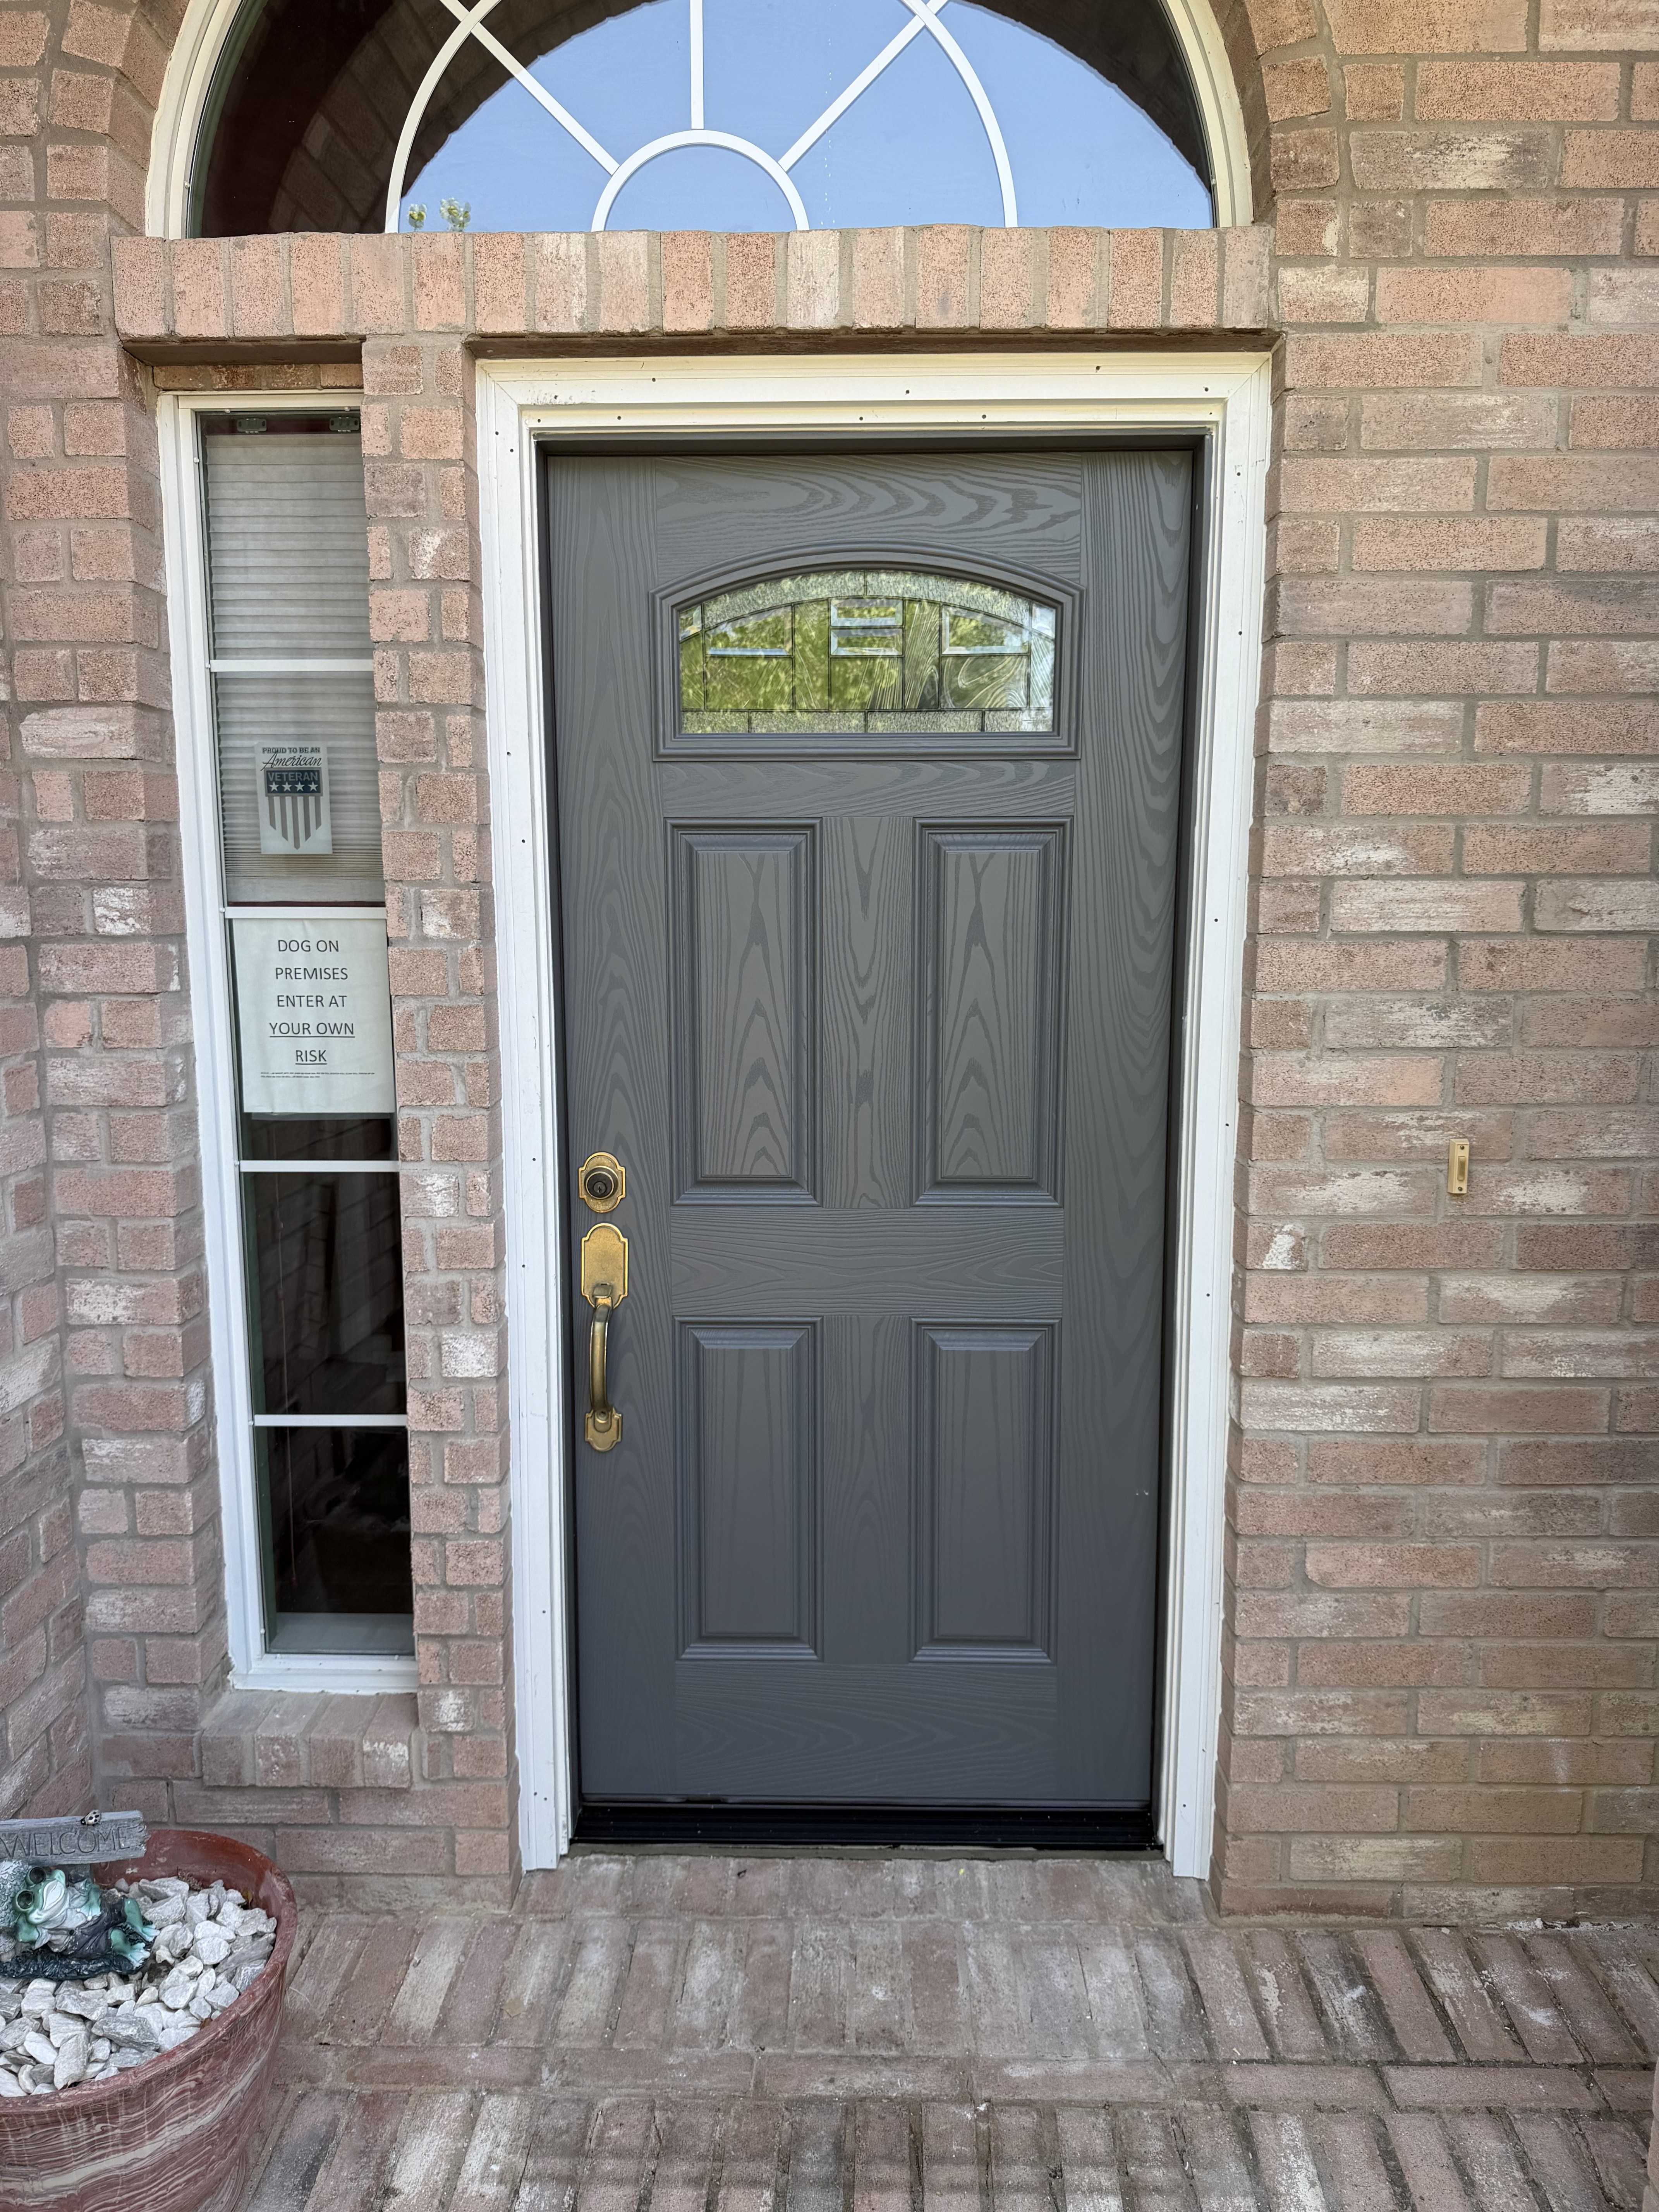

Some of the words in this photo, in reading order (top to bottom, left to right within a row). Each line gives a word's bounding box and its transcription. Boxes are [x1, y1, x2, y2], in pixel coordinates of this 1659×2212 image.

[261, 750, 322, 771] American
[268, 772, 318, 781] VETERAN
[278, 940, 311, 952] DOG
[316, 940, 339, 952] ON
[275, 967, 348, 980] PREMISES
[277, 995, 325, 1007] ENTER
[329, 995, 347, 1007] AT
[270, 1023, 311, 1035] YOUR
[316, 1023, 354, 1035] OWN
[295, 1050, 327, 1062] RISK
[0, 1826, 130, 1858] WELCOME
